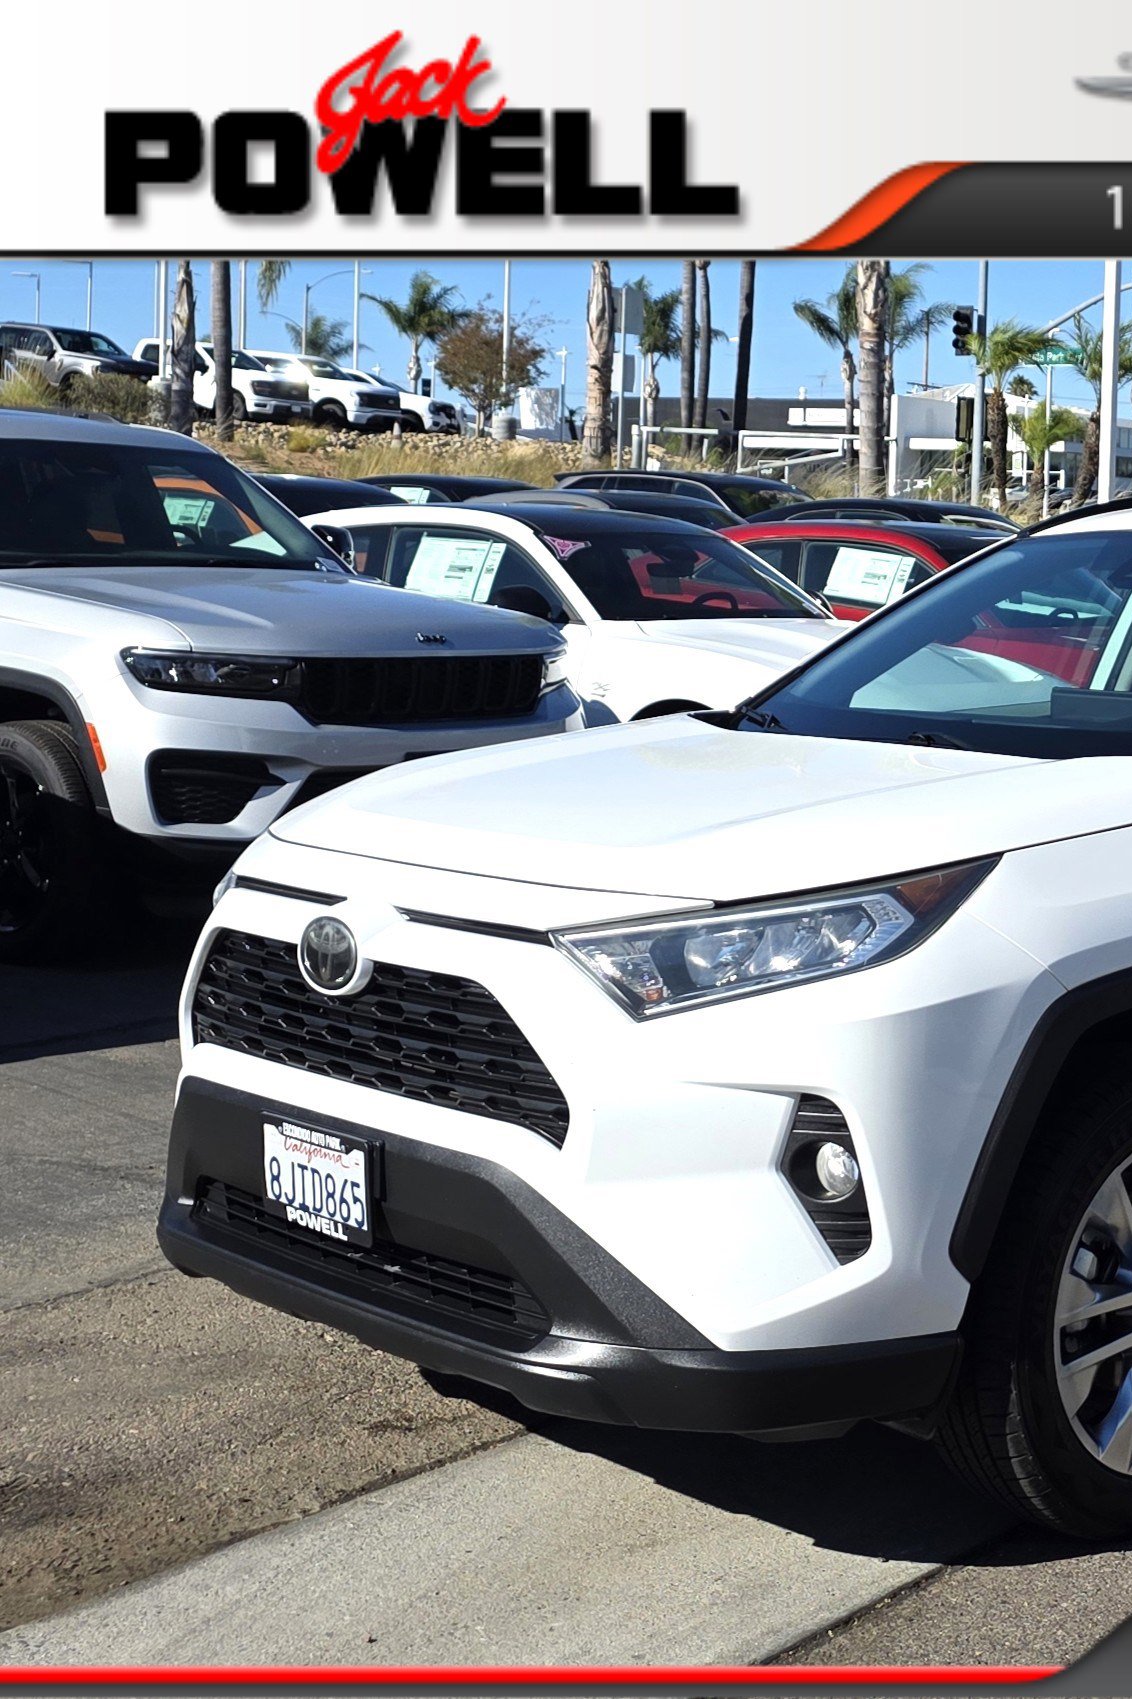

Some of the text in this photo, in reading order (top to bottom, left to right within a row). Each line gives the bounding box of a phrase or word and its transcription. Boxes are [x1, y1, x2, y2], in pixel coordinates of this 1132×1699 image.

[284, 1136, 350, 1169] California
[269, 1155, 365, 1229] 8JID865
[285, 1205, 348, 1242] POWELL
